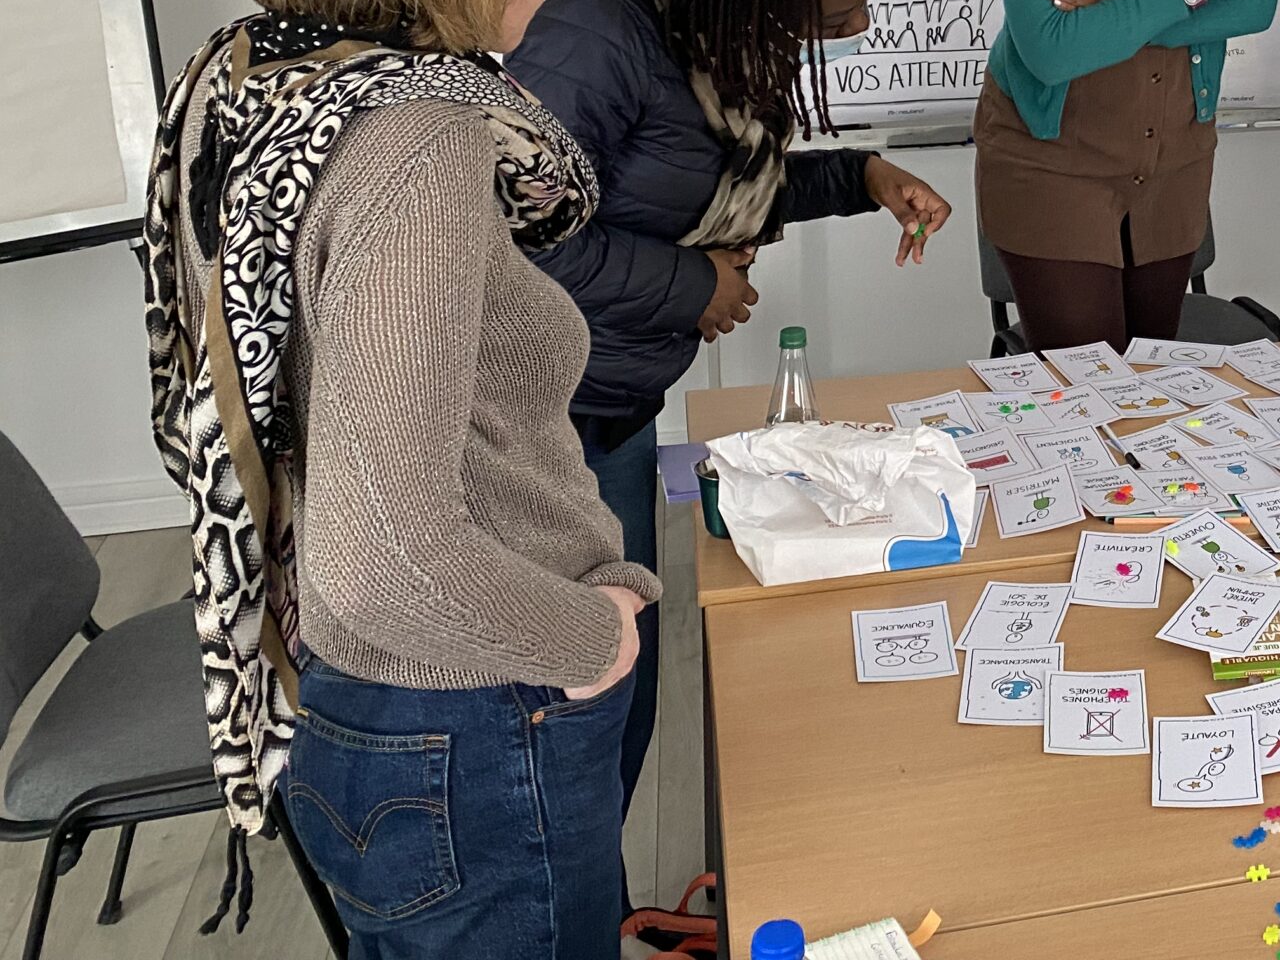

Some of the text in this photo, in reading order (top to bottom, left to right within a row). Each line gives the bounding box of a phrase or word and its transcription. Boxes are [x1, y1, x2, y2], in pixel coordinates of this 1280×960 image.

[835, 59, 987, 94] VOS ATTENTE
[960, 440, 1005, 455] GRIGNOTAG
[1036, 435, 1091, 449] TUTOIEMENT
[1158, 475, 1195, 484] PARTAGE
[1169, 521, 1215, 544] OUVERTU
[1094, 544, 1153, 553] CRÉATIVITÉ
[1227, 586, 1265, 598] COMMUN
[999, 599, 1050, 609] ÉCOLOGIE
[1262, 643, 1280, 651] QUE
[978, 658, 1052, 666] TRANSCENDANCE
[1181, 729, 1235, 741] LOYAUTÉ
